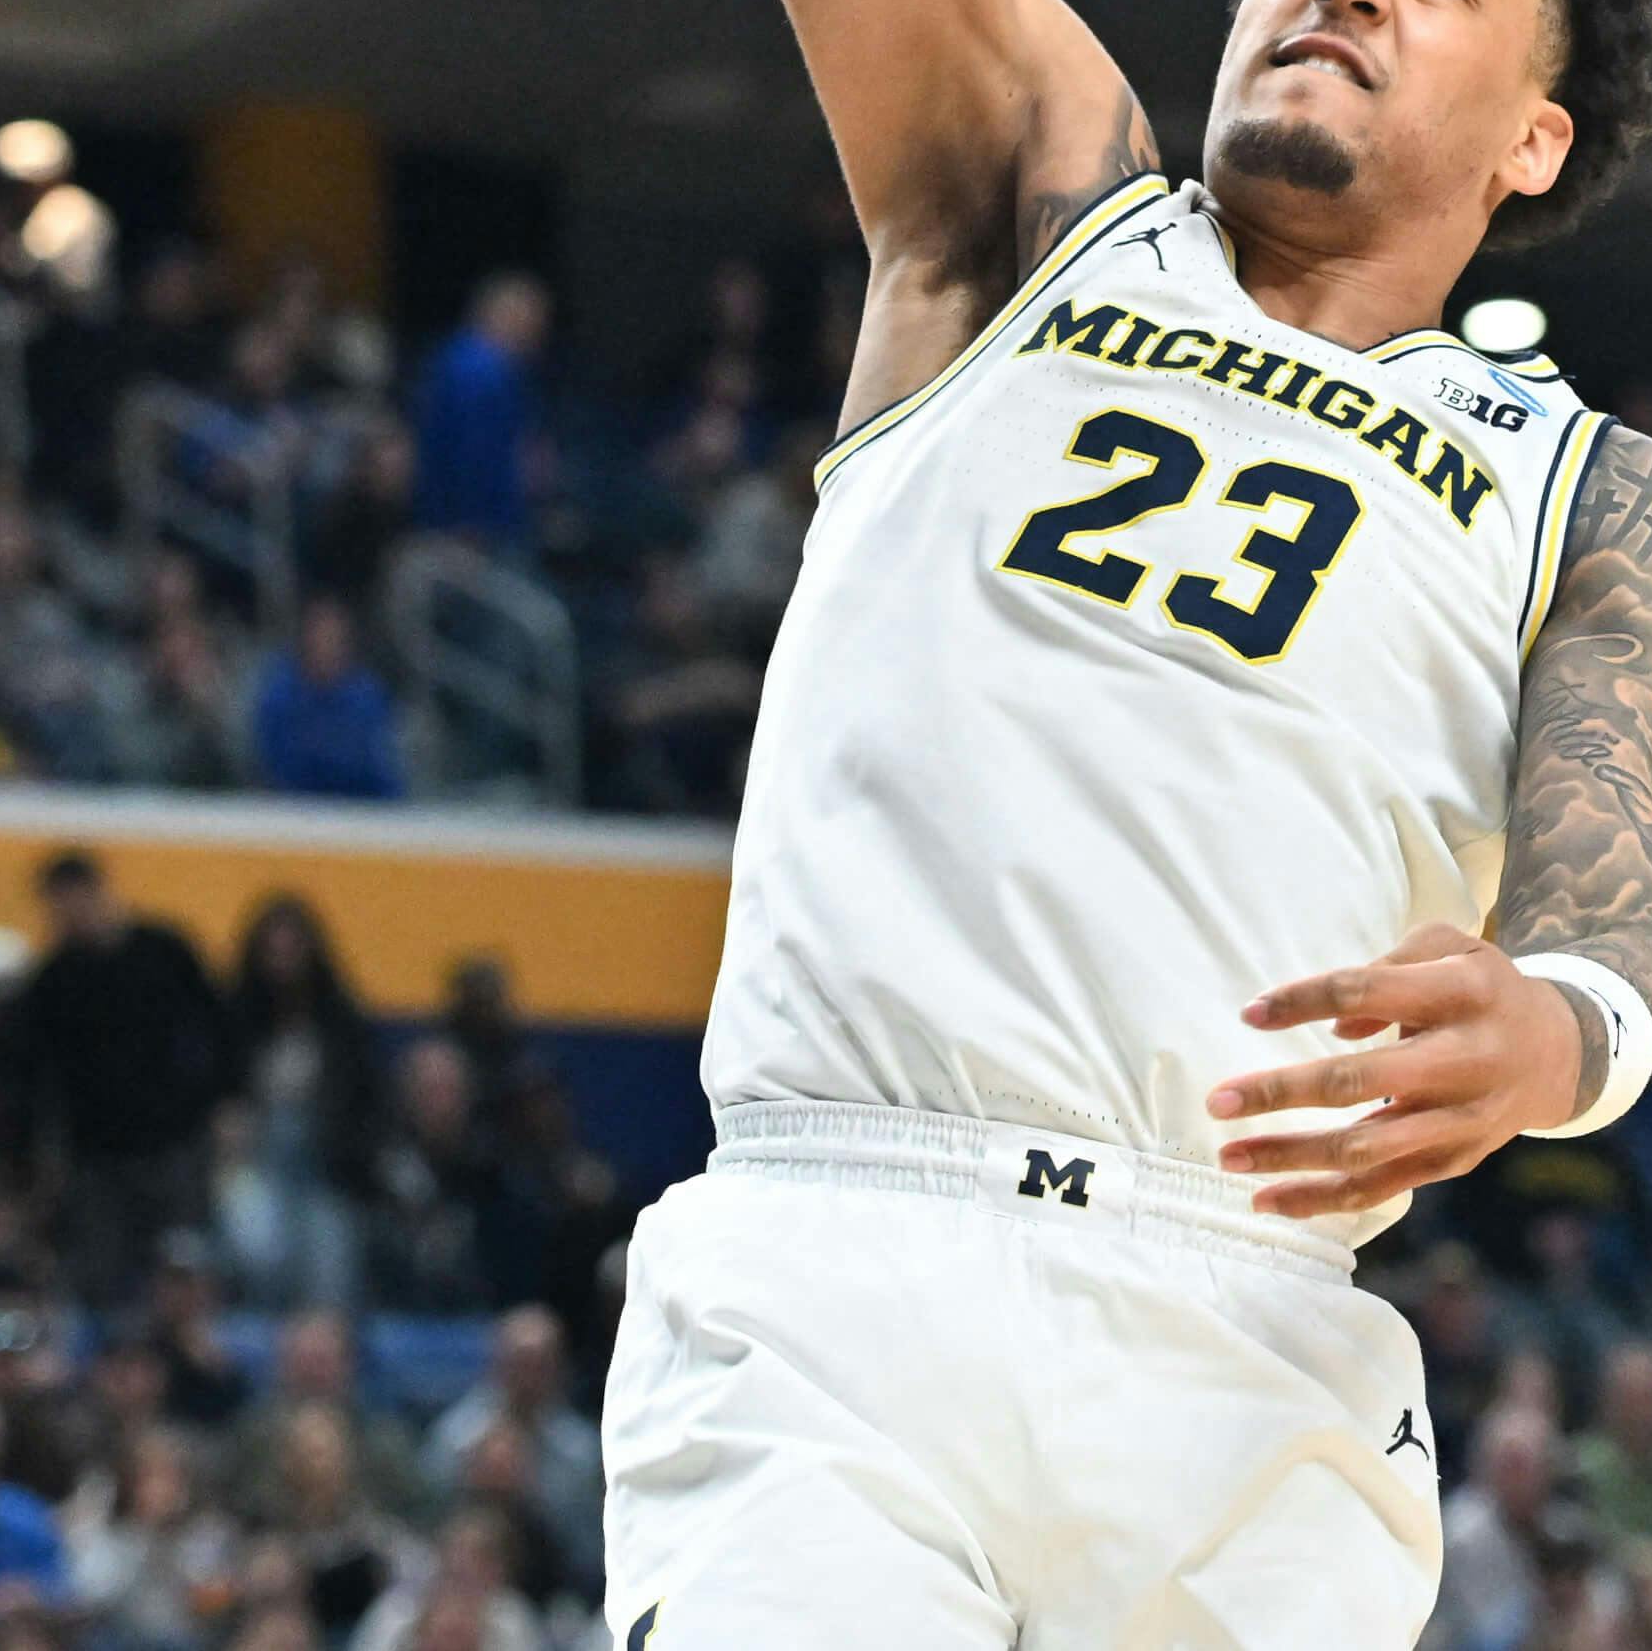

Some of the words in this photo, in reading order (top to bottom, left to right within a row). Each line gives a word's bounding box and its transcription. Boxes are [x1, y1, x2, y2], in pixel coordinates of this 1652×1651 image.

[1011, 298, 1494, 535] MICHIGAN
[994, 405, 1368, 667] 23
[1017, 1148, 1096, 1208] M
